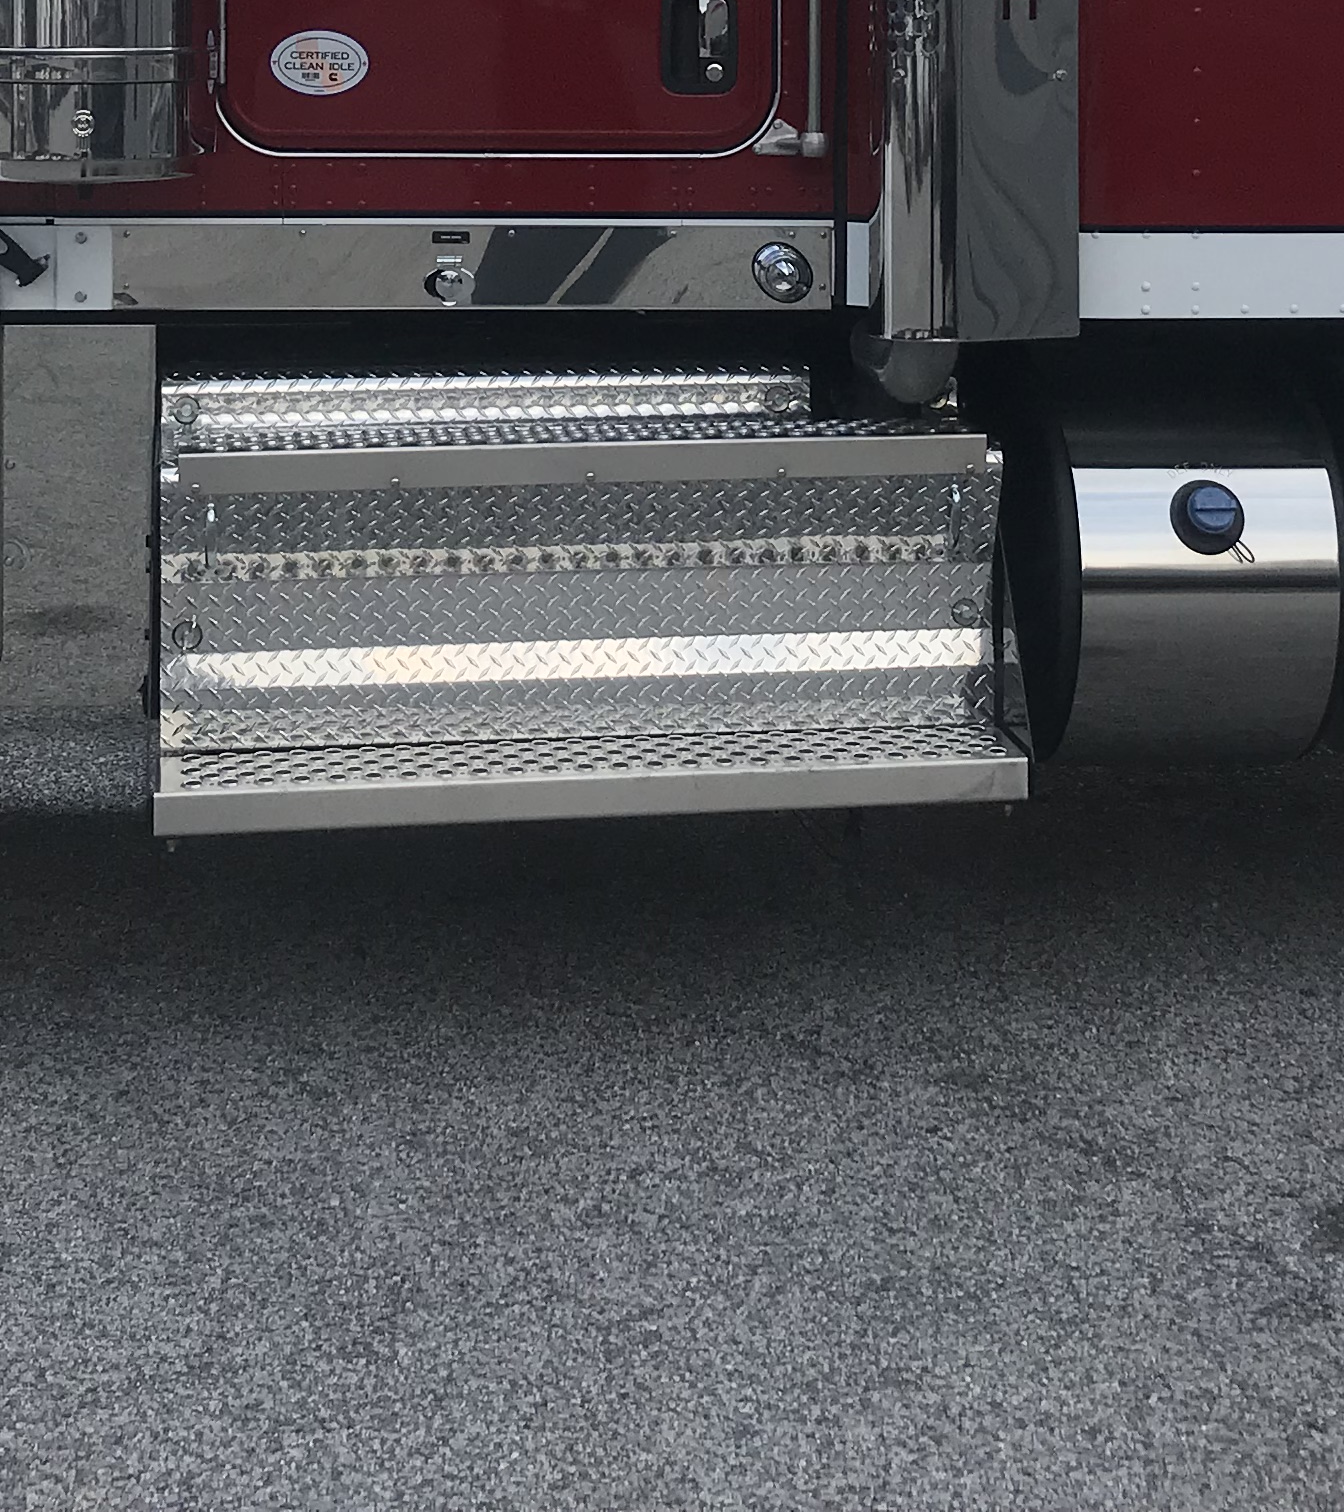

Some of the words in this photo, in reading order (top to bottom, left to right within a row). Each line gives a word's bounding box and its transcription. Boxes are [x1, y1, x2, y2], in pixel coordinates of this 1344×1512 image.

[290, 50, 350, 60] CERTIFIED
[284, 61, 324, 71] CLEAN
[329, 62, 355, 71] IDLE
[1167, 461, 1190, 479] DEF
